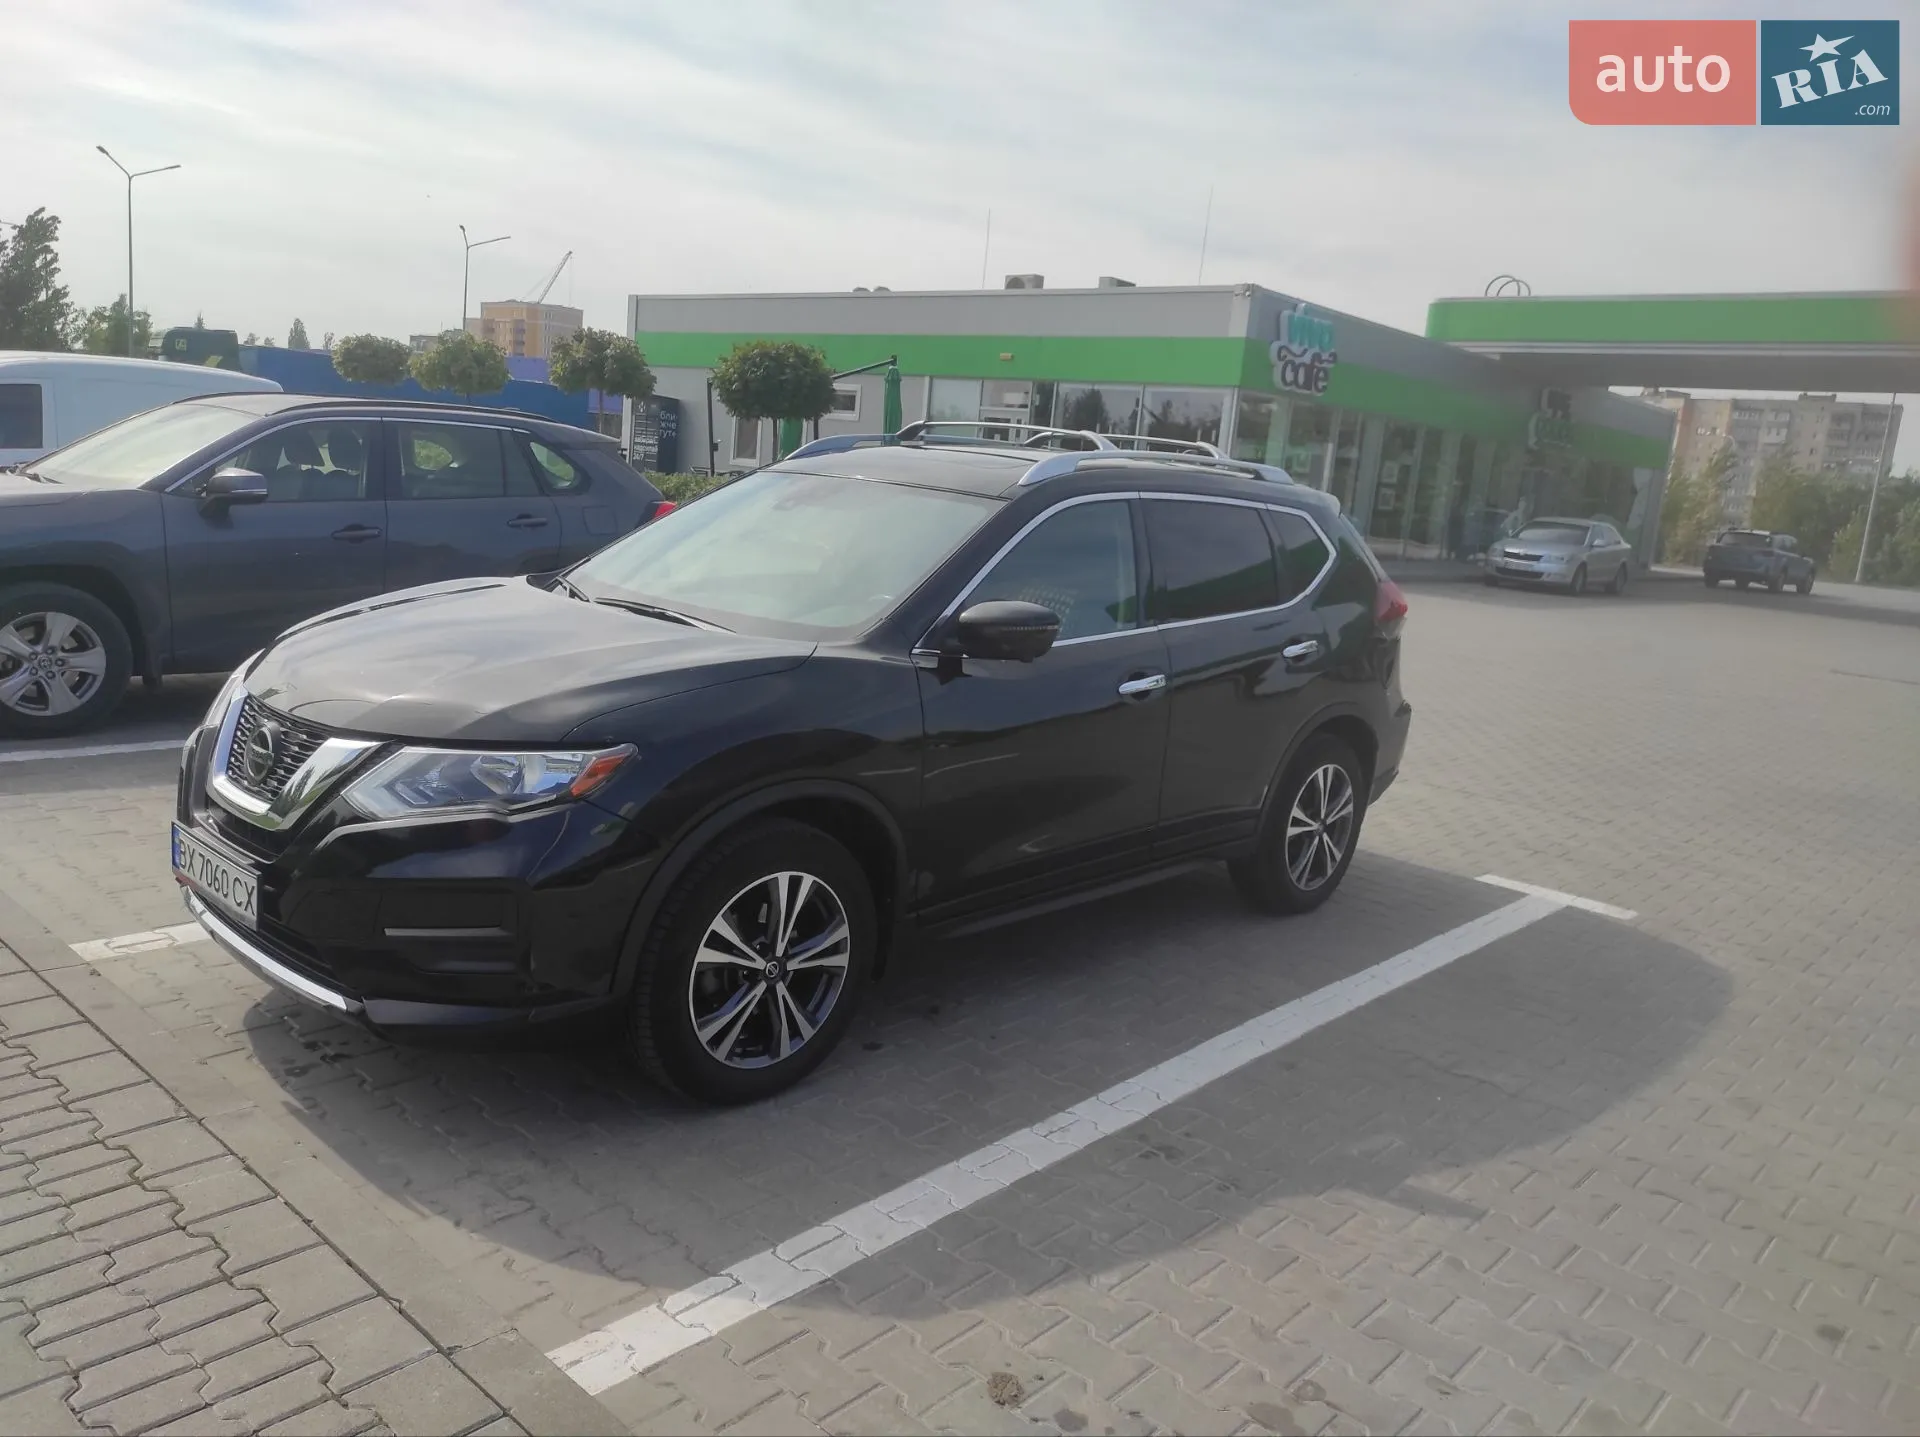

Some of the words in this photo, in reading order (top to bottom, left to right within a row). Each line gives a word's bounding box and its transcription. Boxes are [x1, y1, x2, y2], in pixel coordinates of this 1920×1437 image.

[180, 839, 196, 876] BX
[198, 853, 229, 898] 7060
[233, 877, 256, 916] CX
